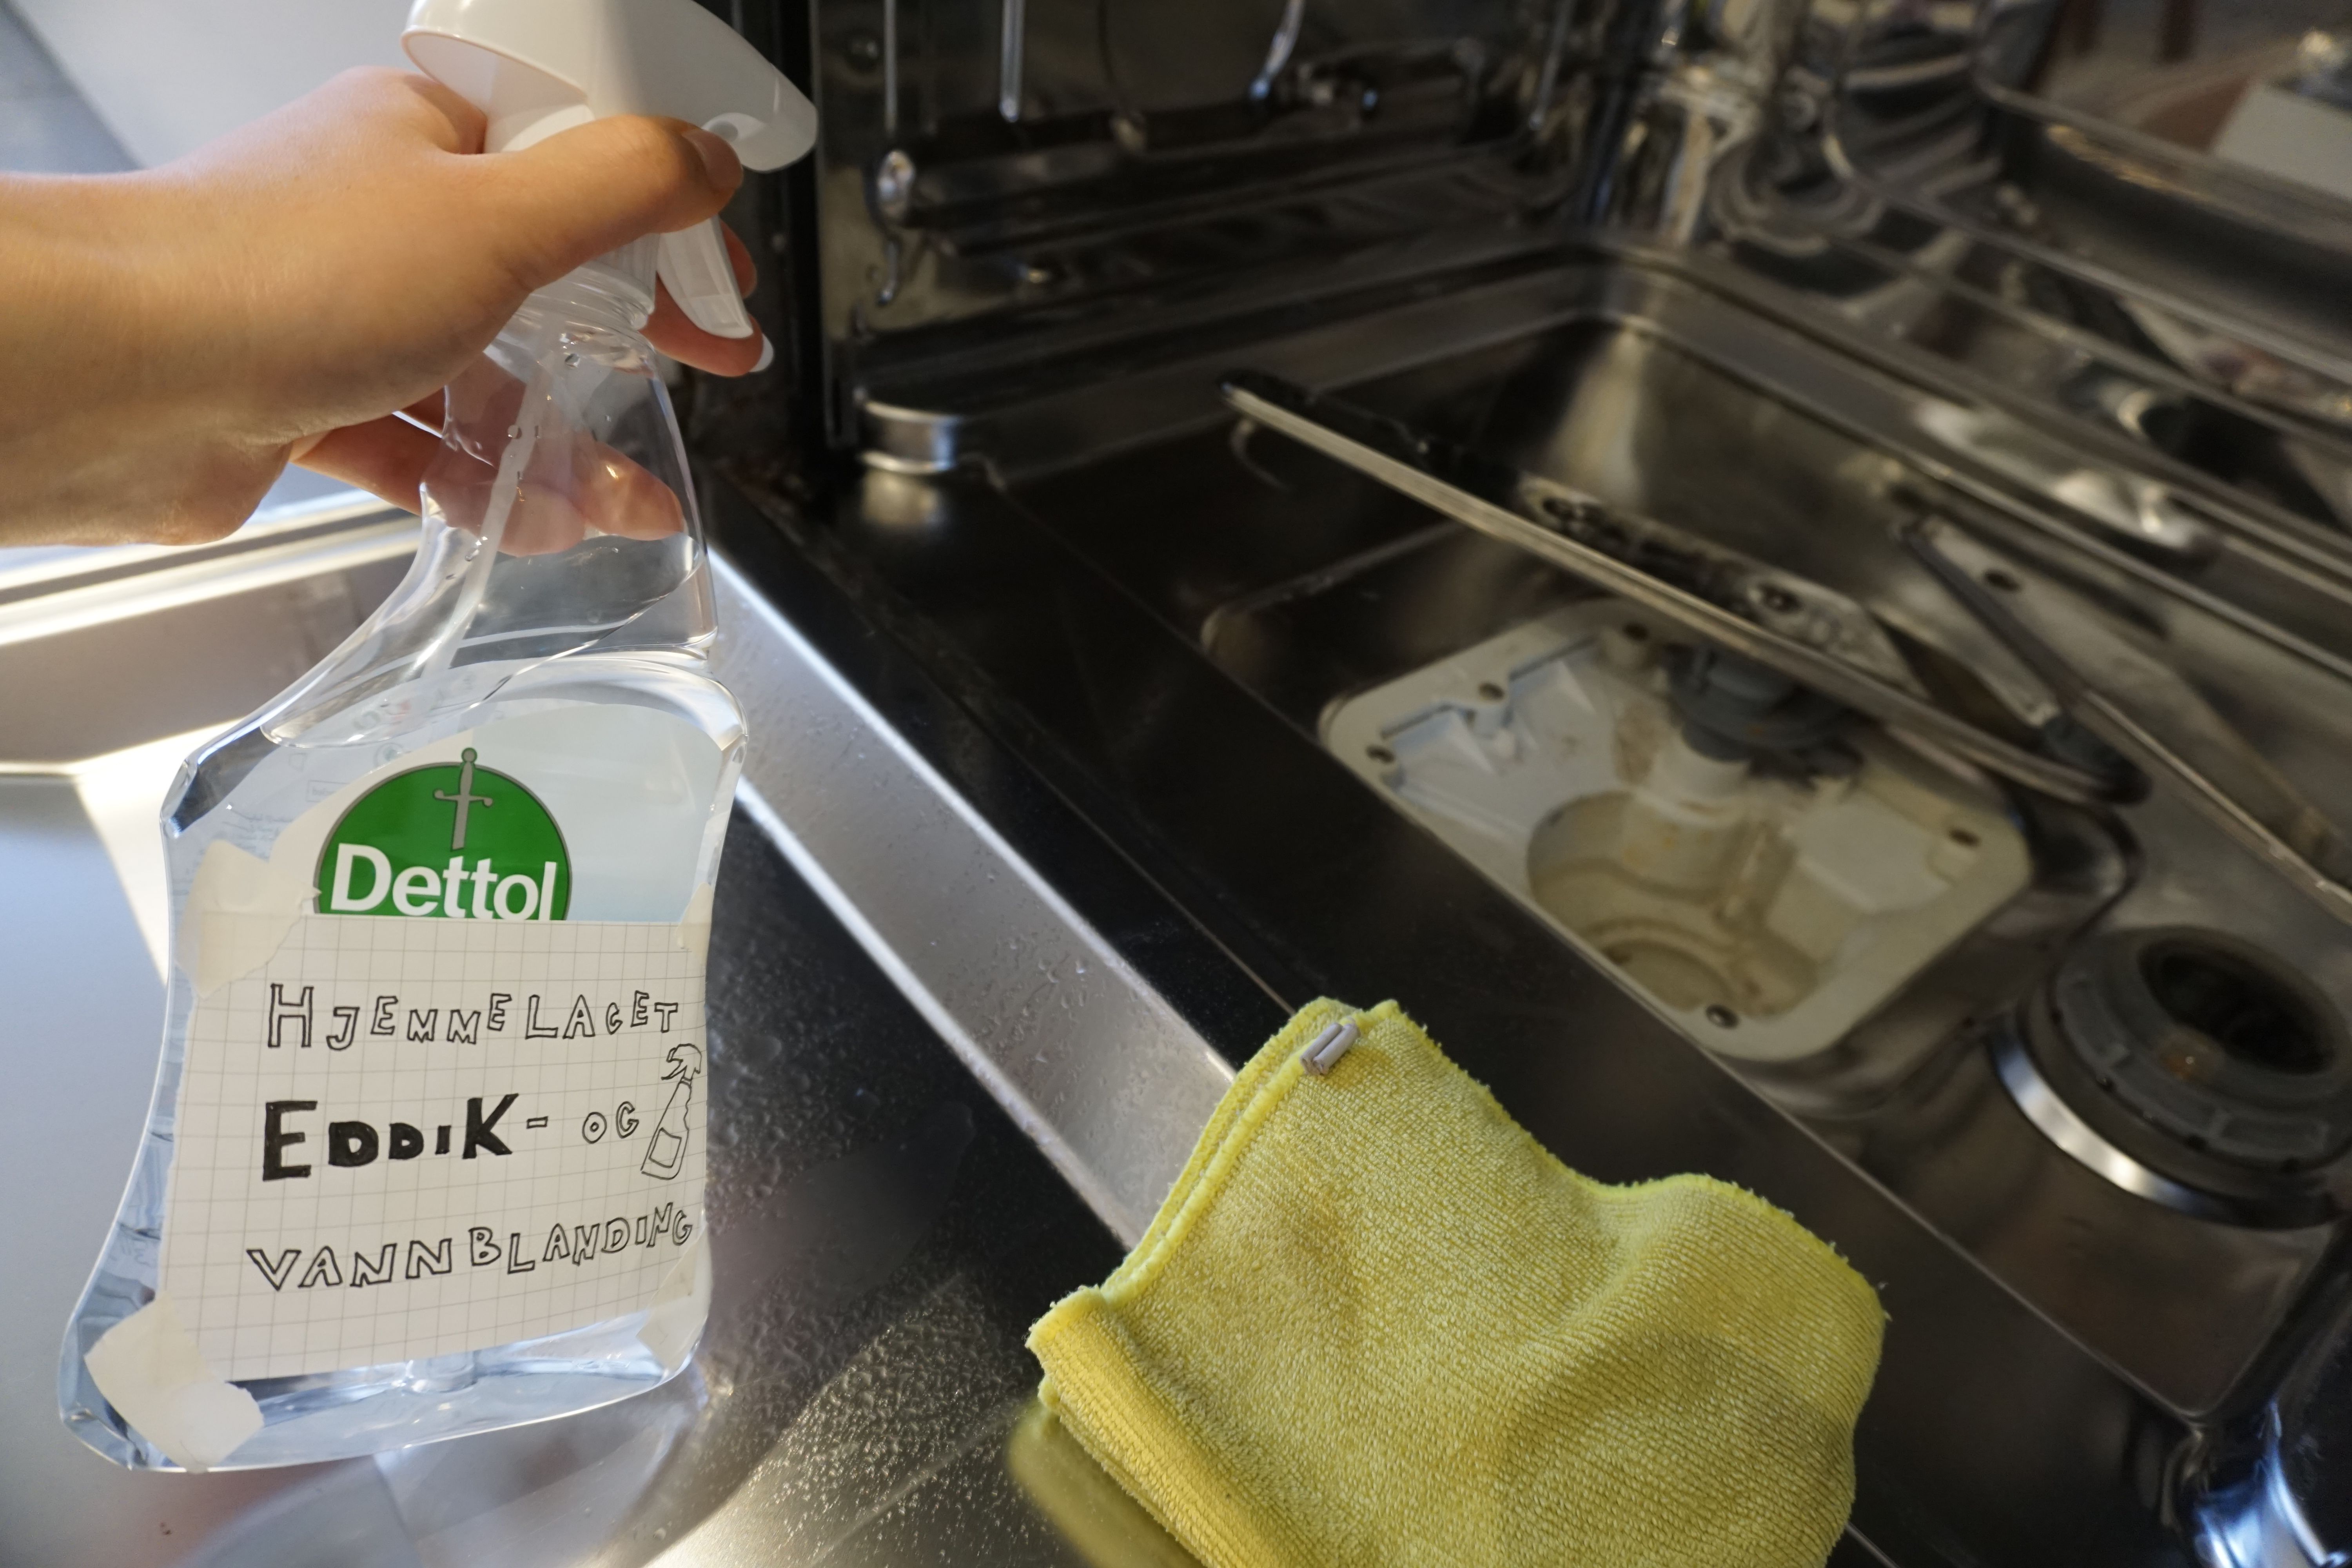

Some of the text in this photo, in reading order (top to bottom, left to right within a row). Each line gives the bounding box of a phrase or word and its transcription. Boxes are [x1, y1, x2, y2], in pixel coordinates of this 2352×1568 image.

[330, 842, 557, 921] Dettol
[268, 983, 678, 1051] HJEMMELAGET
[582, 1101, 639, 1144] OG
[246, 1202, 693, 1291] VANNBLANDING
